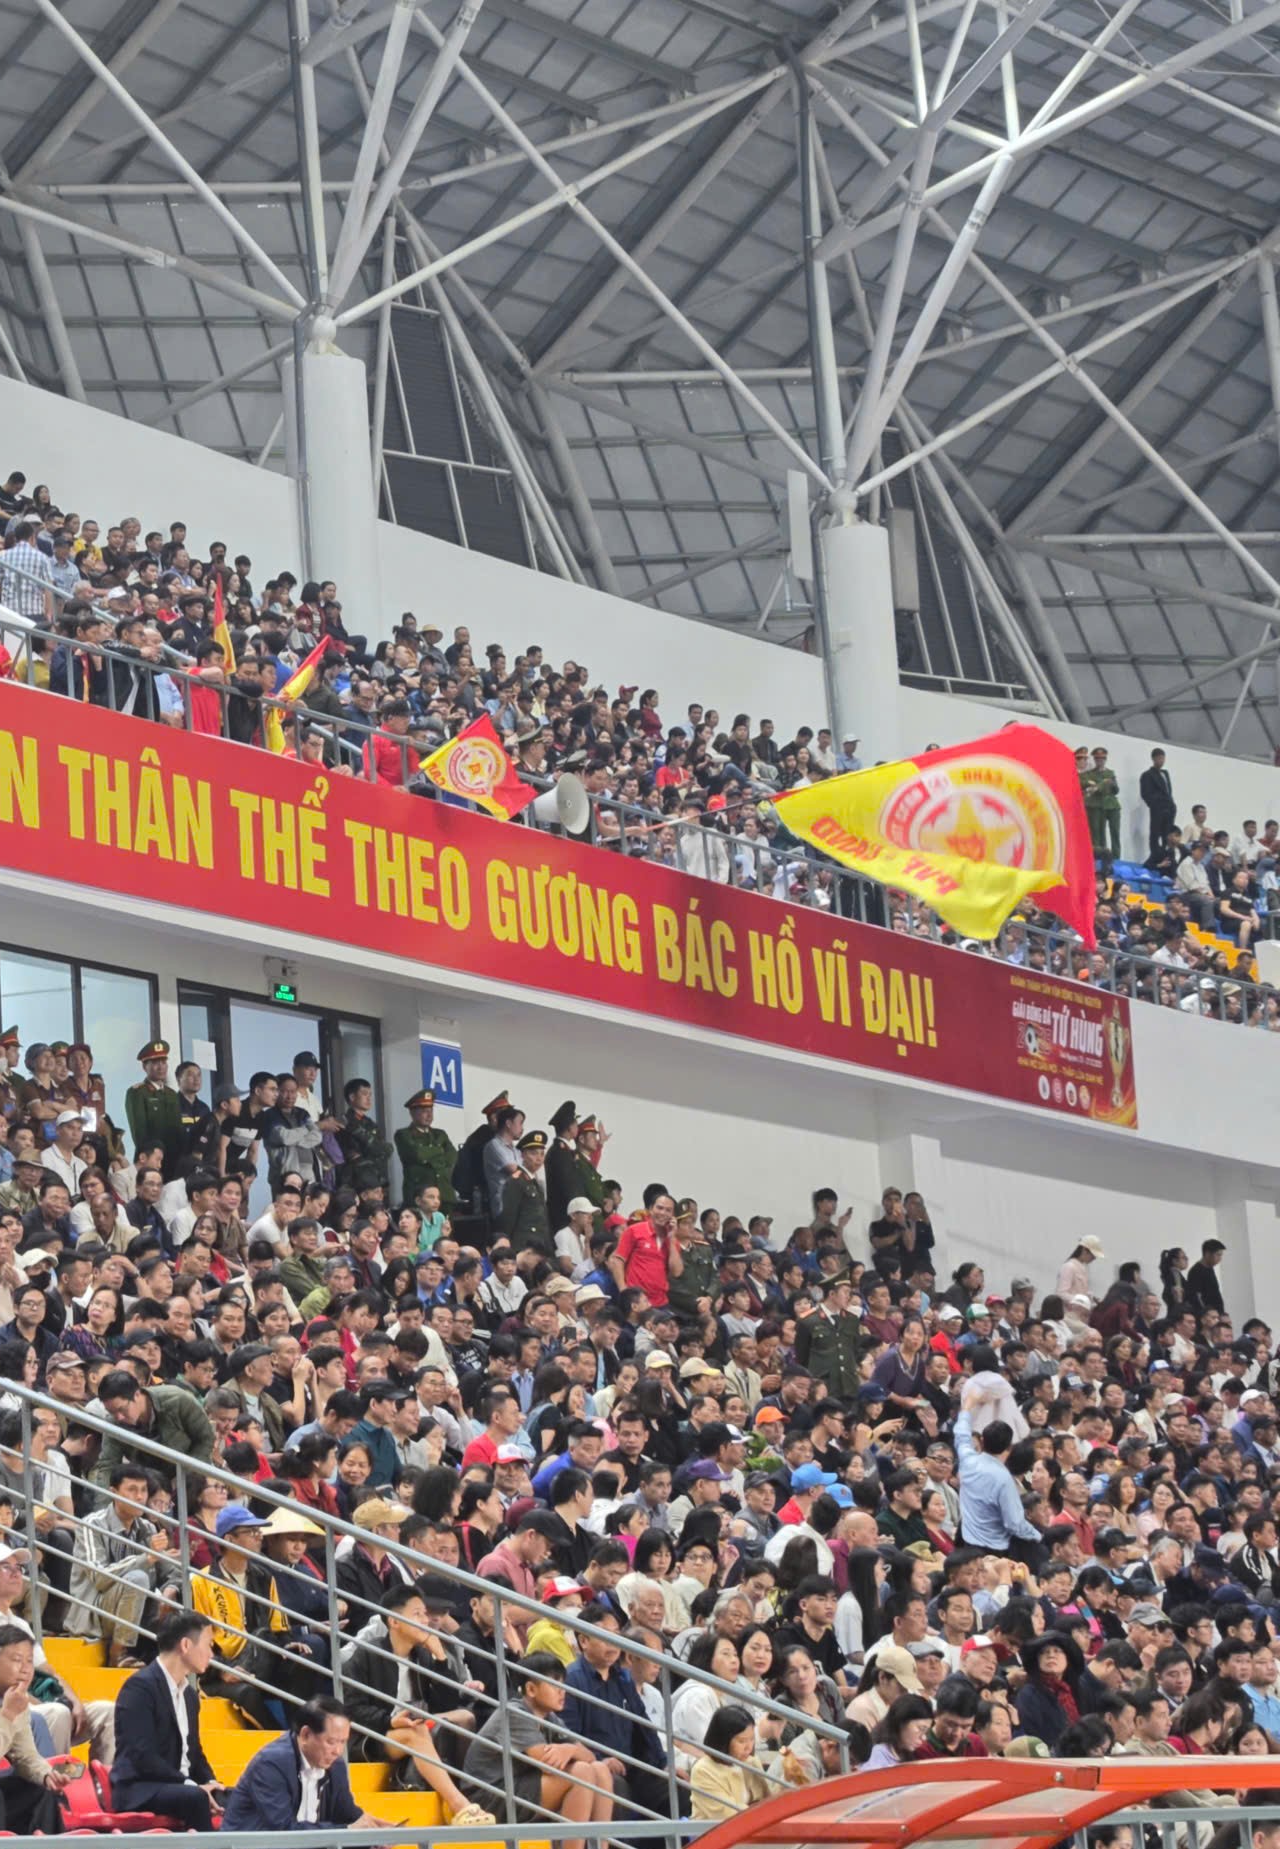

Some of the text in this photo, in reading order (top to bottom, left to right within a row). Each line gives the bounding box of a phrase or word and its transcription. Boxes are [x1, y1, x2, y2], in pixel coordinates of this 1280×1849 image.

[58, 745, 213, 869] THÂN
[229, 776, 331, 897] THỂ
[345, 819, 471, 932] THEO
[486, 859, 643, 973] GƯƠNG
[653, 898, 738, 998] BÁC
[748, 915, 803, 1015] HỒ
[812, 940, 851, 1027] VĨ
[860, 960, 937, 1056] ĐẠI!
[1070, 1010, 1104, 1058] HÙNG
[430, 1056, 457, 1094] A1
